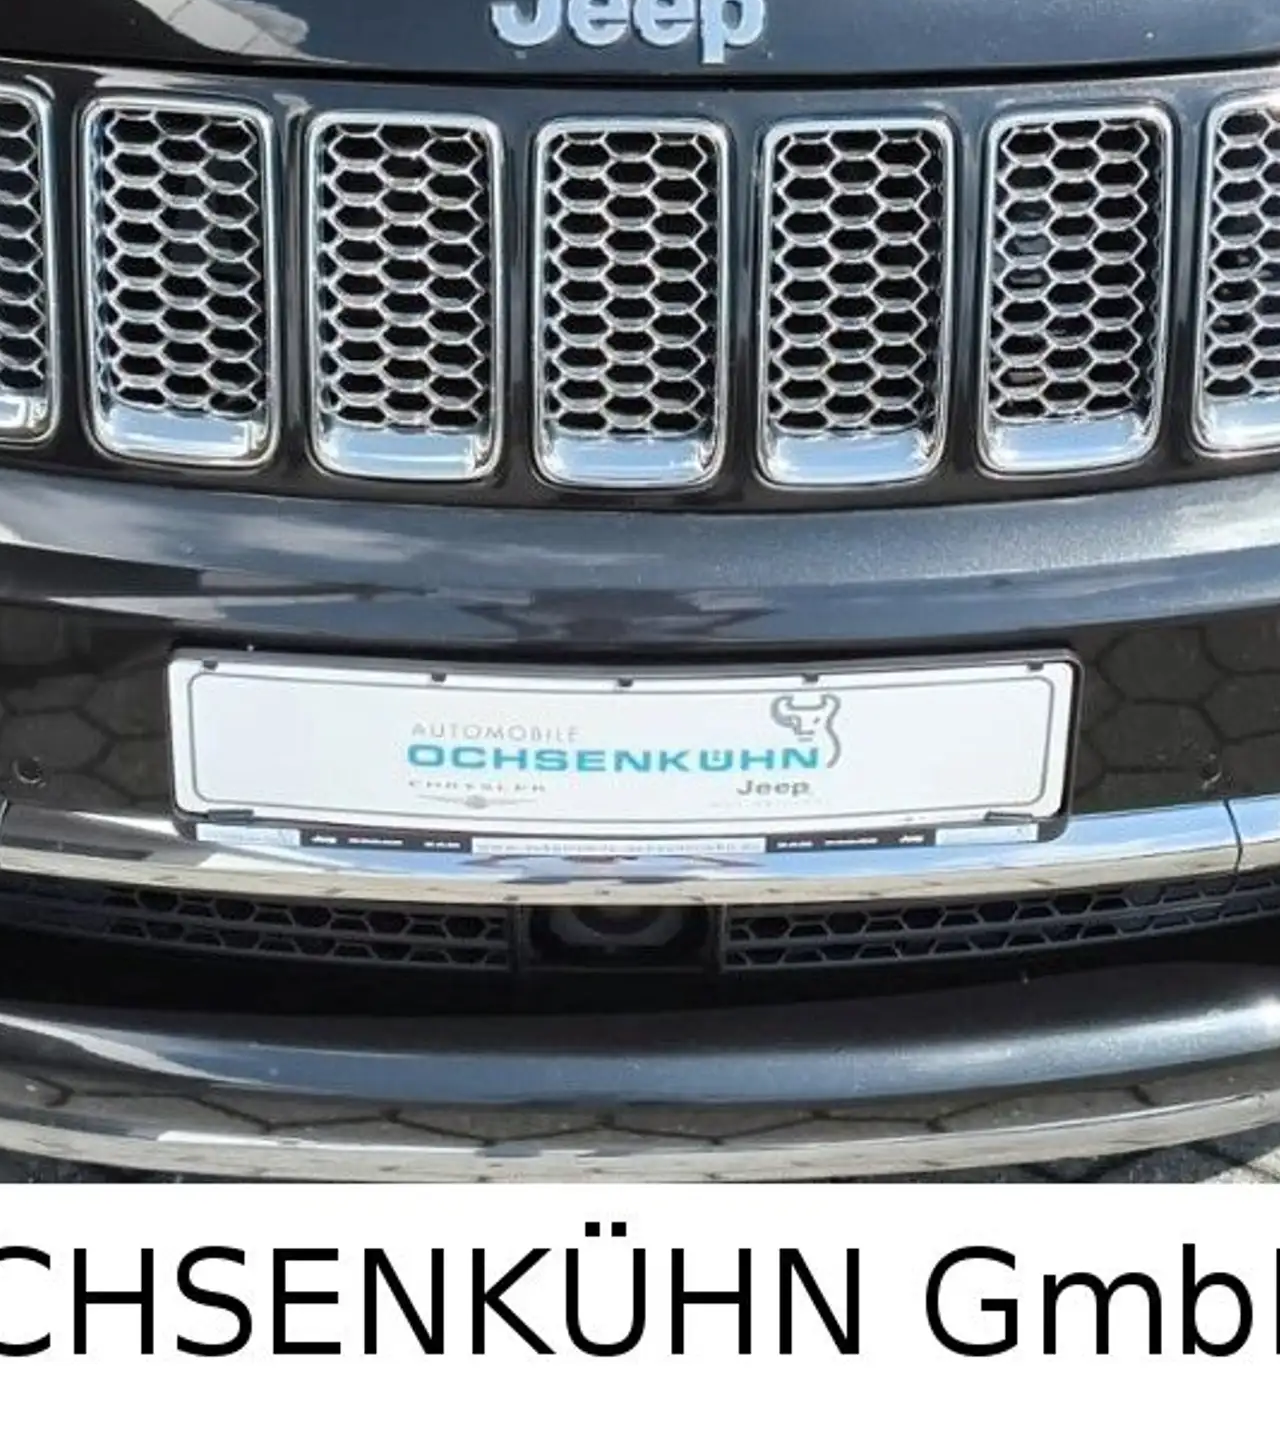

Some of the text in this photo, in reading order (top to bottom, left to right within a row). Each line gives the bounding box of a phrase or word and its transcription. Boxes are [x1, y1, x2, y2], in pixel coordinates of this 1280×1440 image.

[411, 722, 580, 743] AUTOMOBILE
[407, 744, 820, 773] OCHSENKÜHN
[735, 779, 811, 798] Jeep
